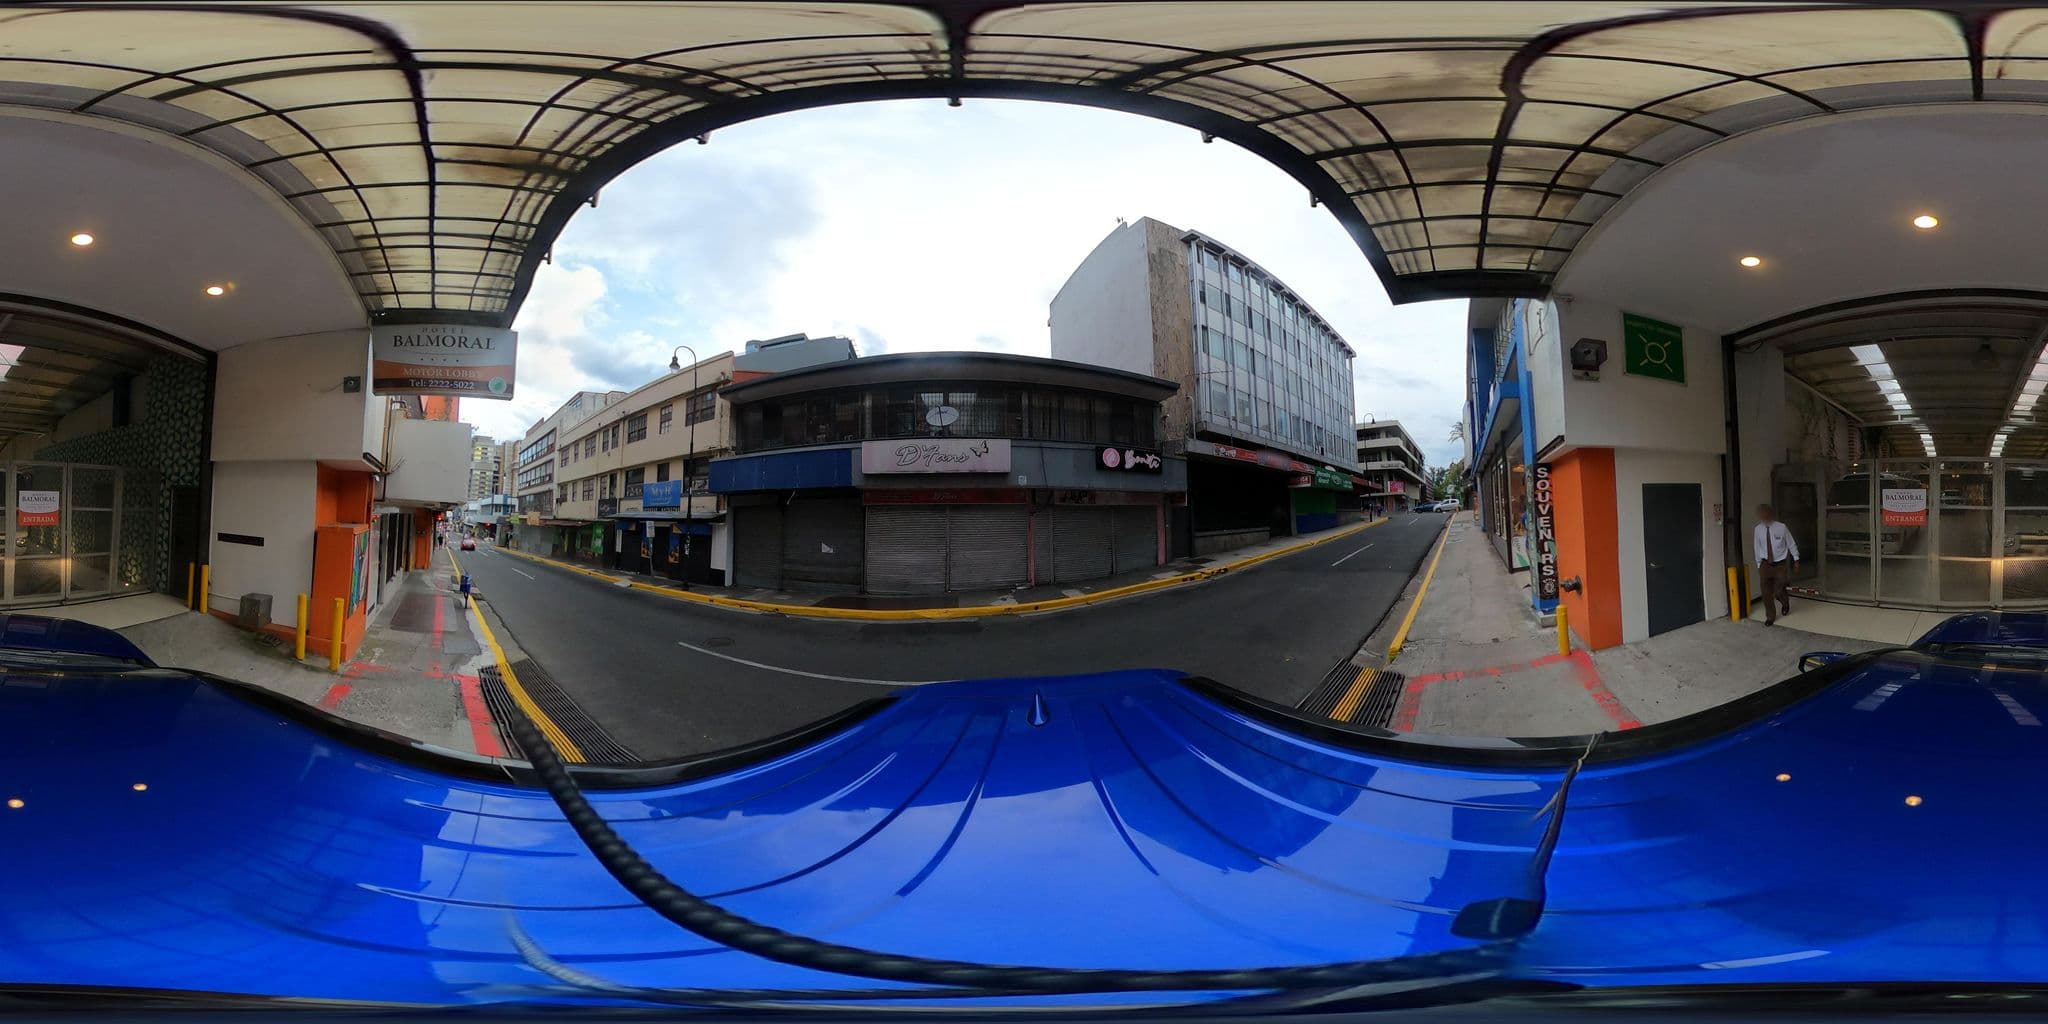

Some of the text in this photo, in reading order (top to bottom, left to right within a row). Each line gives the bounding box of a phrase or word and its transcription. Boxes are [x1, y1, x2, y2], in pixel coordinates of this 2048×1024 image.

[393, 335, 496, 350] BALMORAL
[401, 367, 444, 377] MOTOR
[409, 379, 474, 389] Tel: 2222-5022
[1536, 467, 1555, 576] SOUVENIRS
